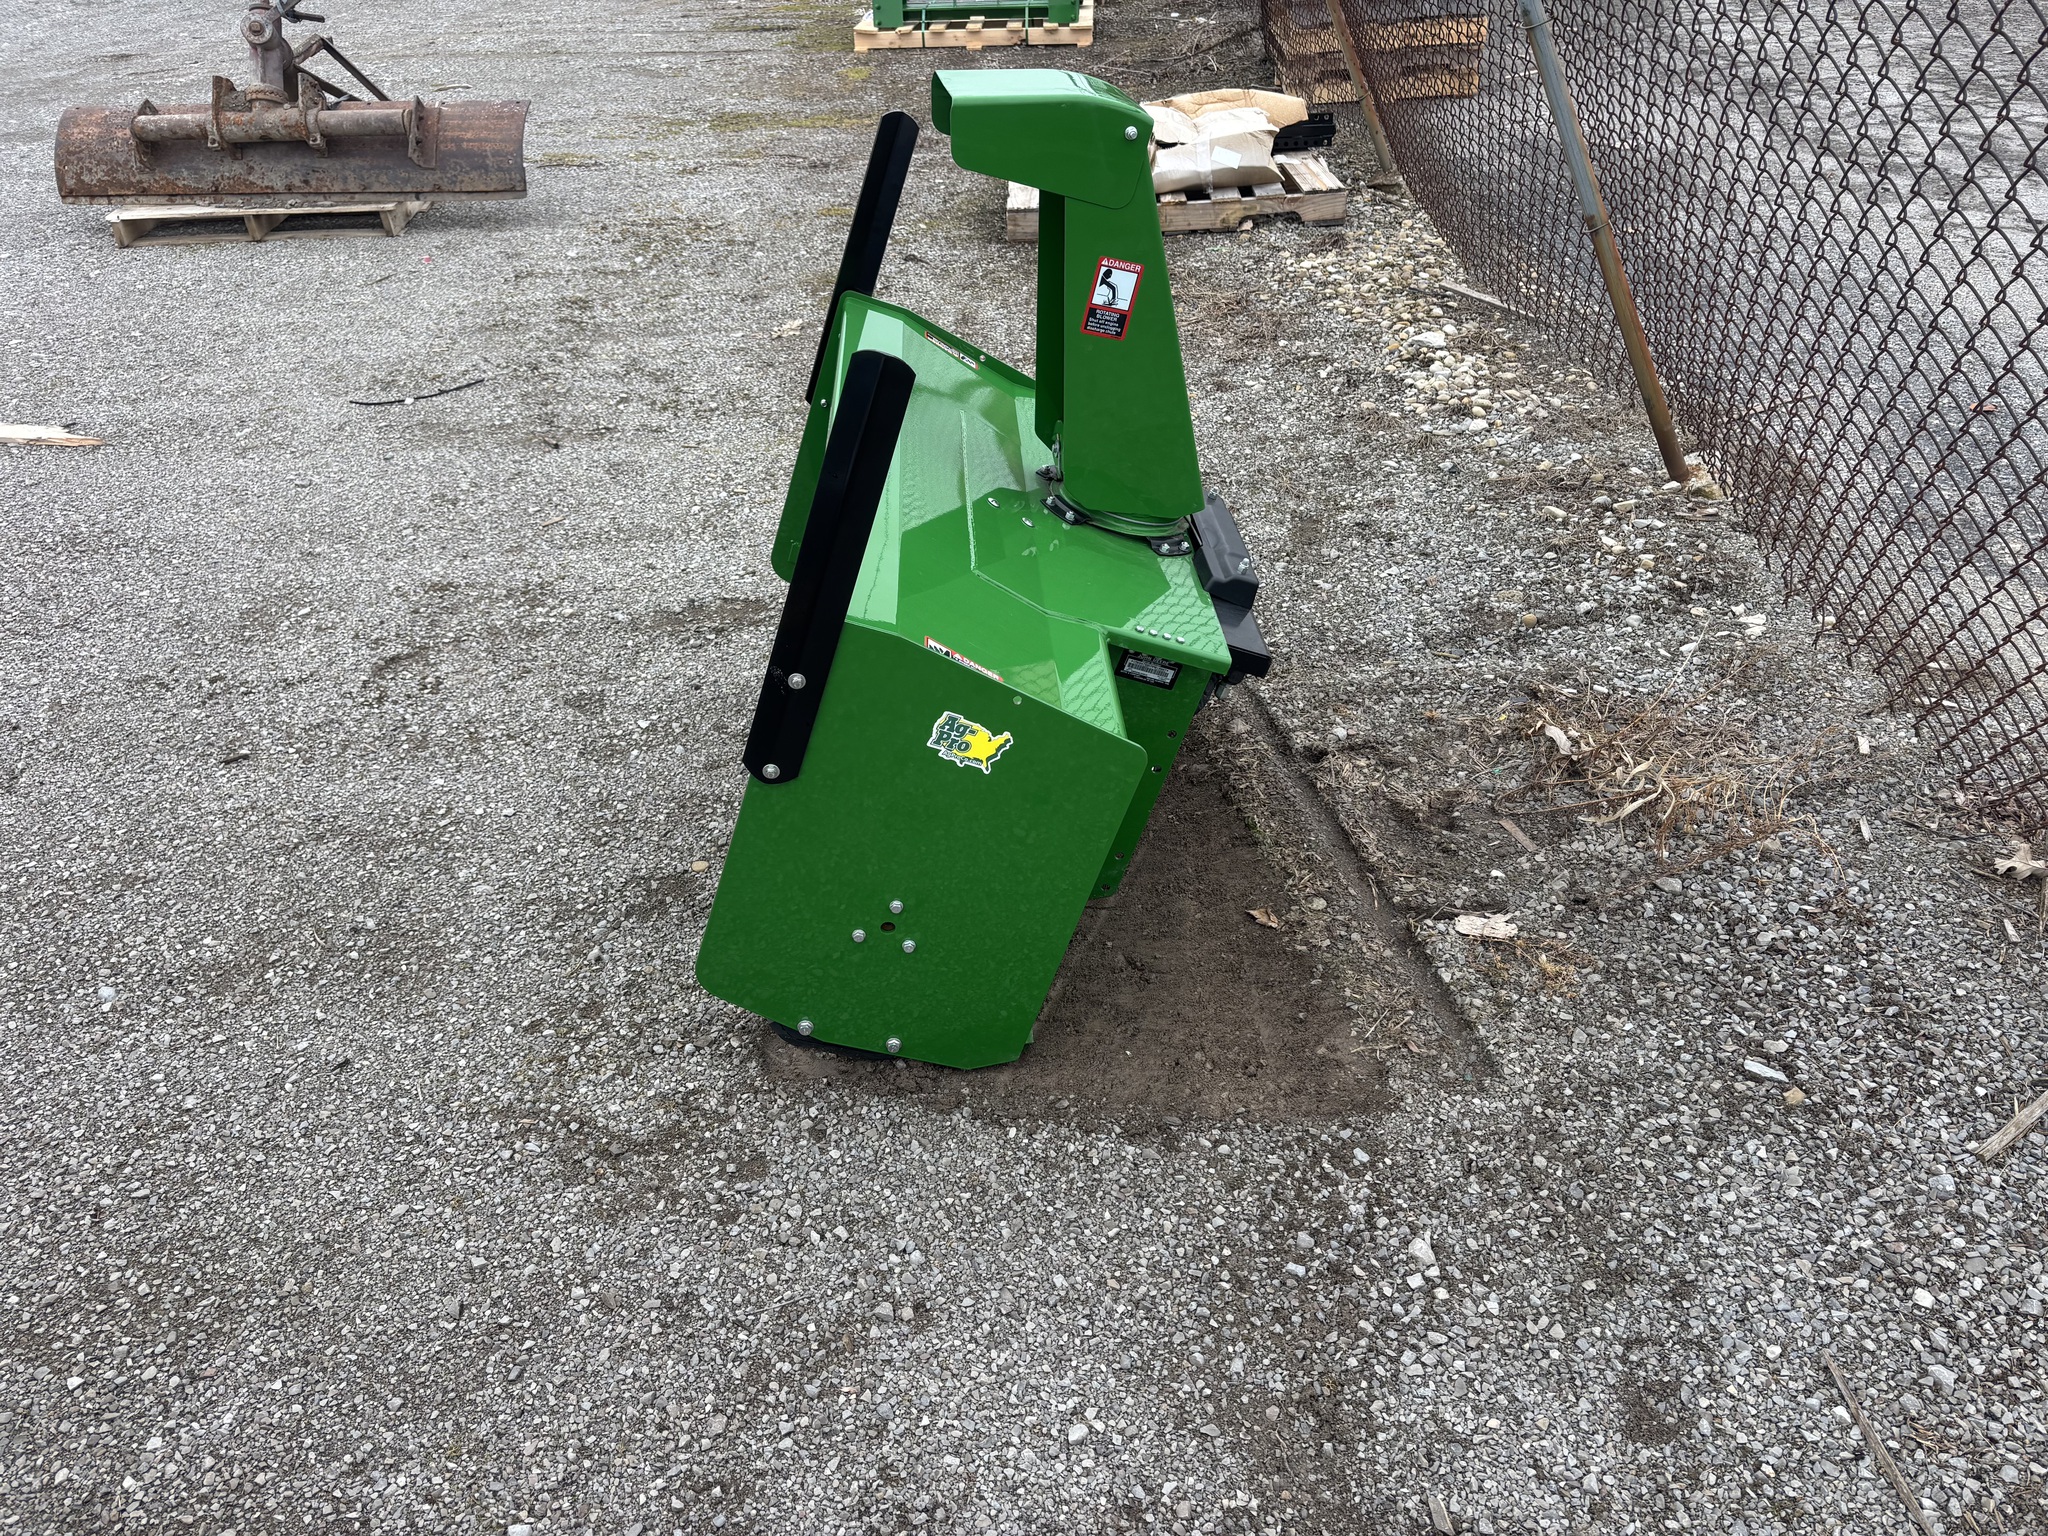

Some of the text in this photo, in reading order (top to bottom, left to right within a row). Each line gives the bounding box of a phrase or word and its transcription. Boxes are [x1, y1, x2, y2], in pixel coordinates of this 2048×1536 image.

[1109, 259, 1141, 272] DANGER
[1096, 309, 1120, 318] ROTATING
[1096, 313, 1118, 322] BLOWER
[938, 715, 977, 738] Ag-
[932, 730, 971, 752] Pro
